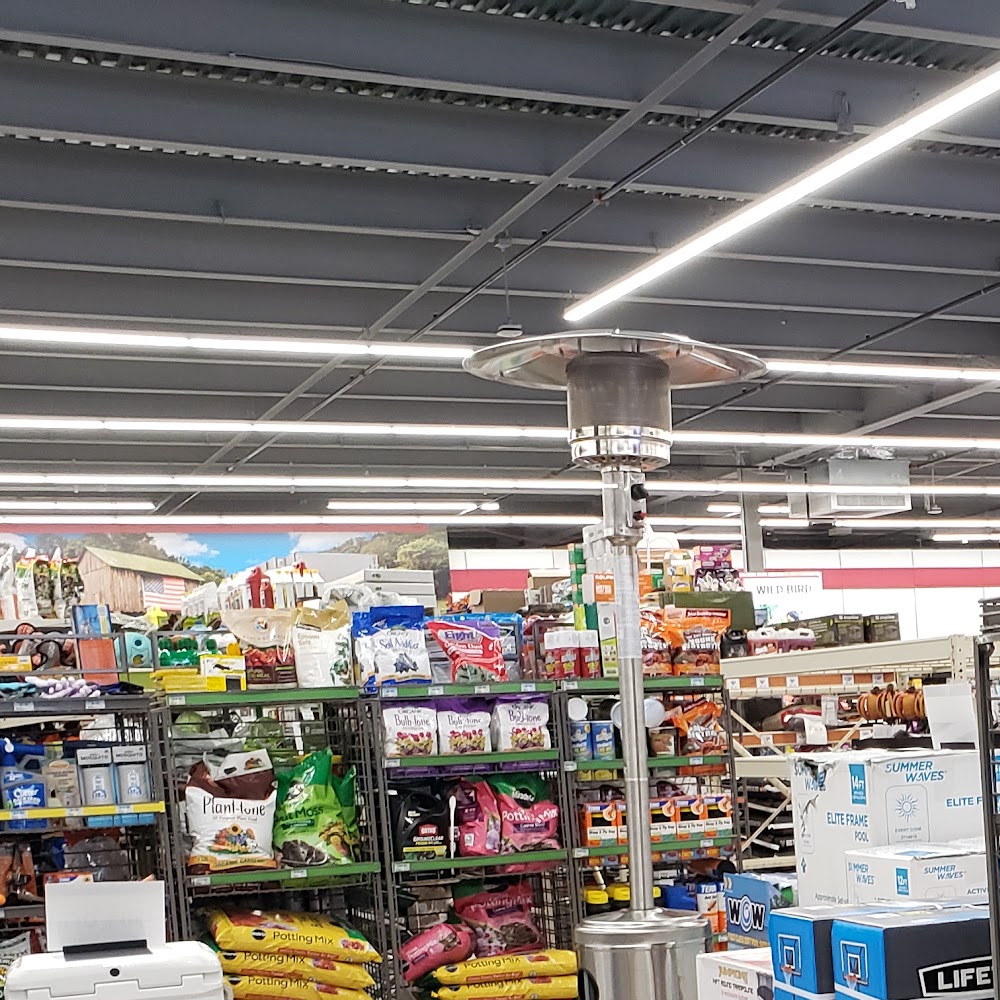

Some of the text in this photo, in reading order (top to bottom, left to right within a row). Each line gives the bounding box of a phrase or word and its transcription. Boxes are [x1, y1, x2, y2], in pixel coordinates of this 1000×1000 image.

[885, 760, 933, 773] SUMMER
[905, 770, 945, 783] WAVES
[203, 796, 266, 816] Plant-tone
[946, 796, 974, 808] ELITE
[294, 805, 324, 818] Moss
[827, 812, 868, 827] ELITE FRAME
[854, 830, 869, 842] POOL
[924, 865, 956, 875] SUMMER
[937, 871, 964, 880] WAVES
[728, 895, 765, 932] WOW
[273, 931, 334, 945] Potting Mix
[243, 952, 284, 963] Potting
[286, 955, 306, 963] Mix
[463, 959, 502, 969] Potting
[248, 976, 309, 990] Potting Mix
[937, 965, 992, 990] LIFE
